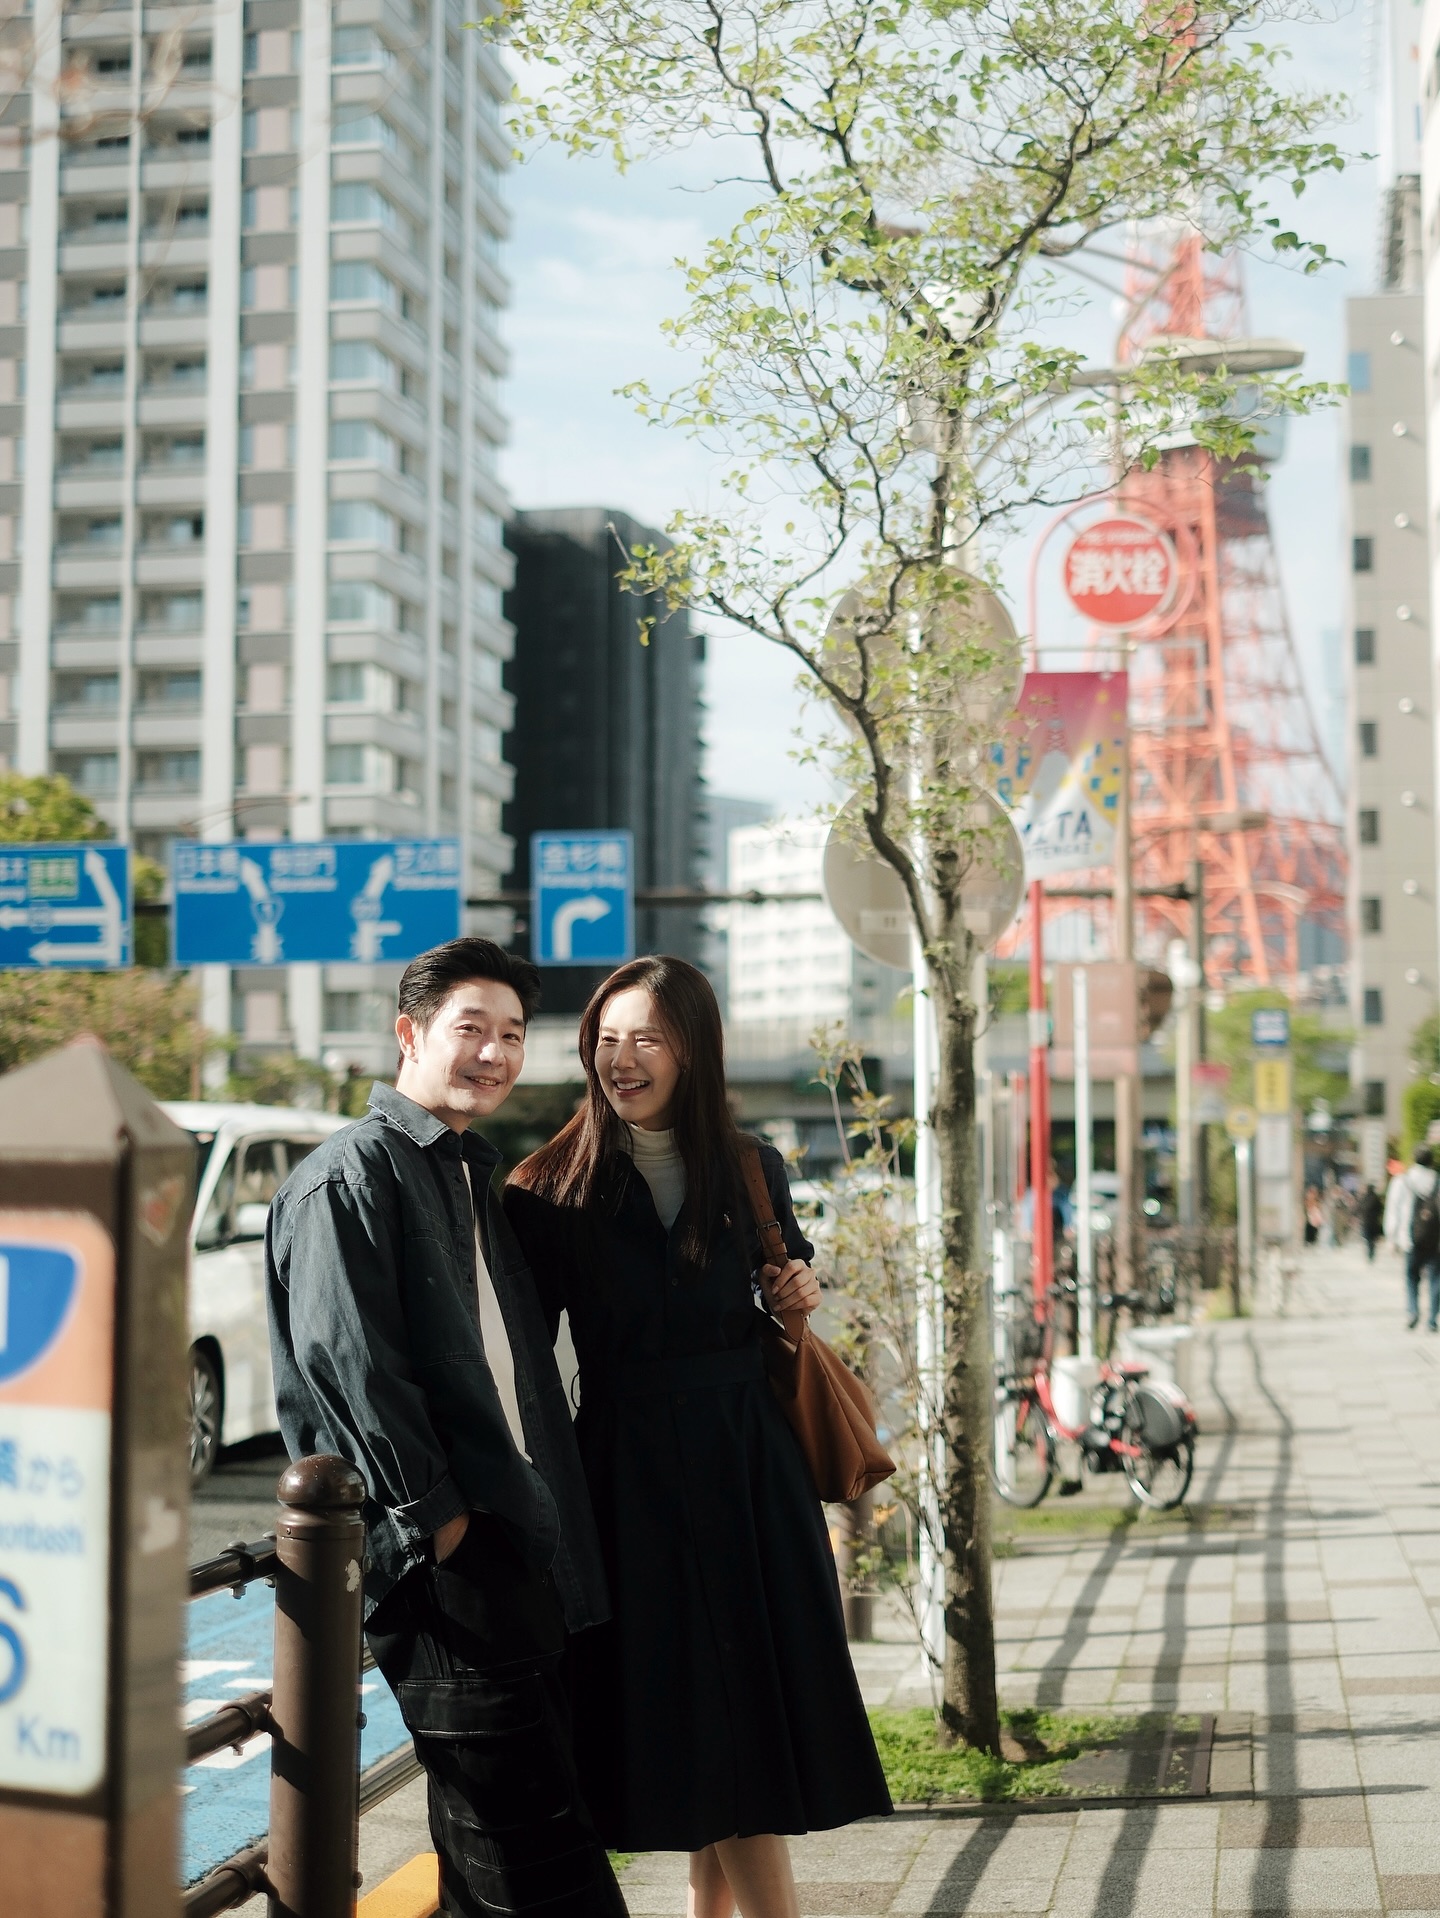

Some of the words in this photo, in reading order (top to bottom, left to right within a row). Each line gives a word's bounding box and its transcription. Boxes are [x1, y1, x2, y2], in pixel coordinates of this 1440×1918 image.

[1069, 546, 1166, 597] 消火栓
[16, 1713, 81, 1764] Km
